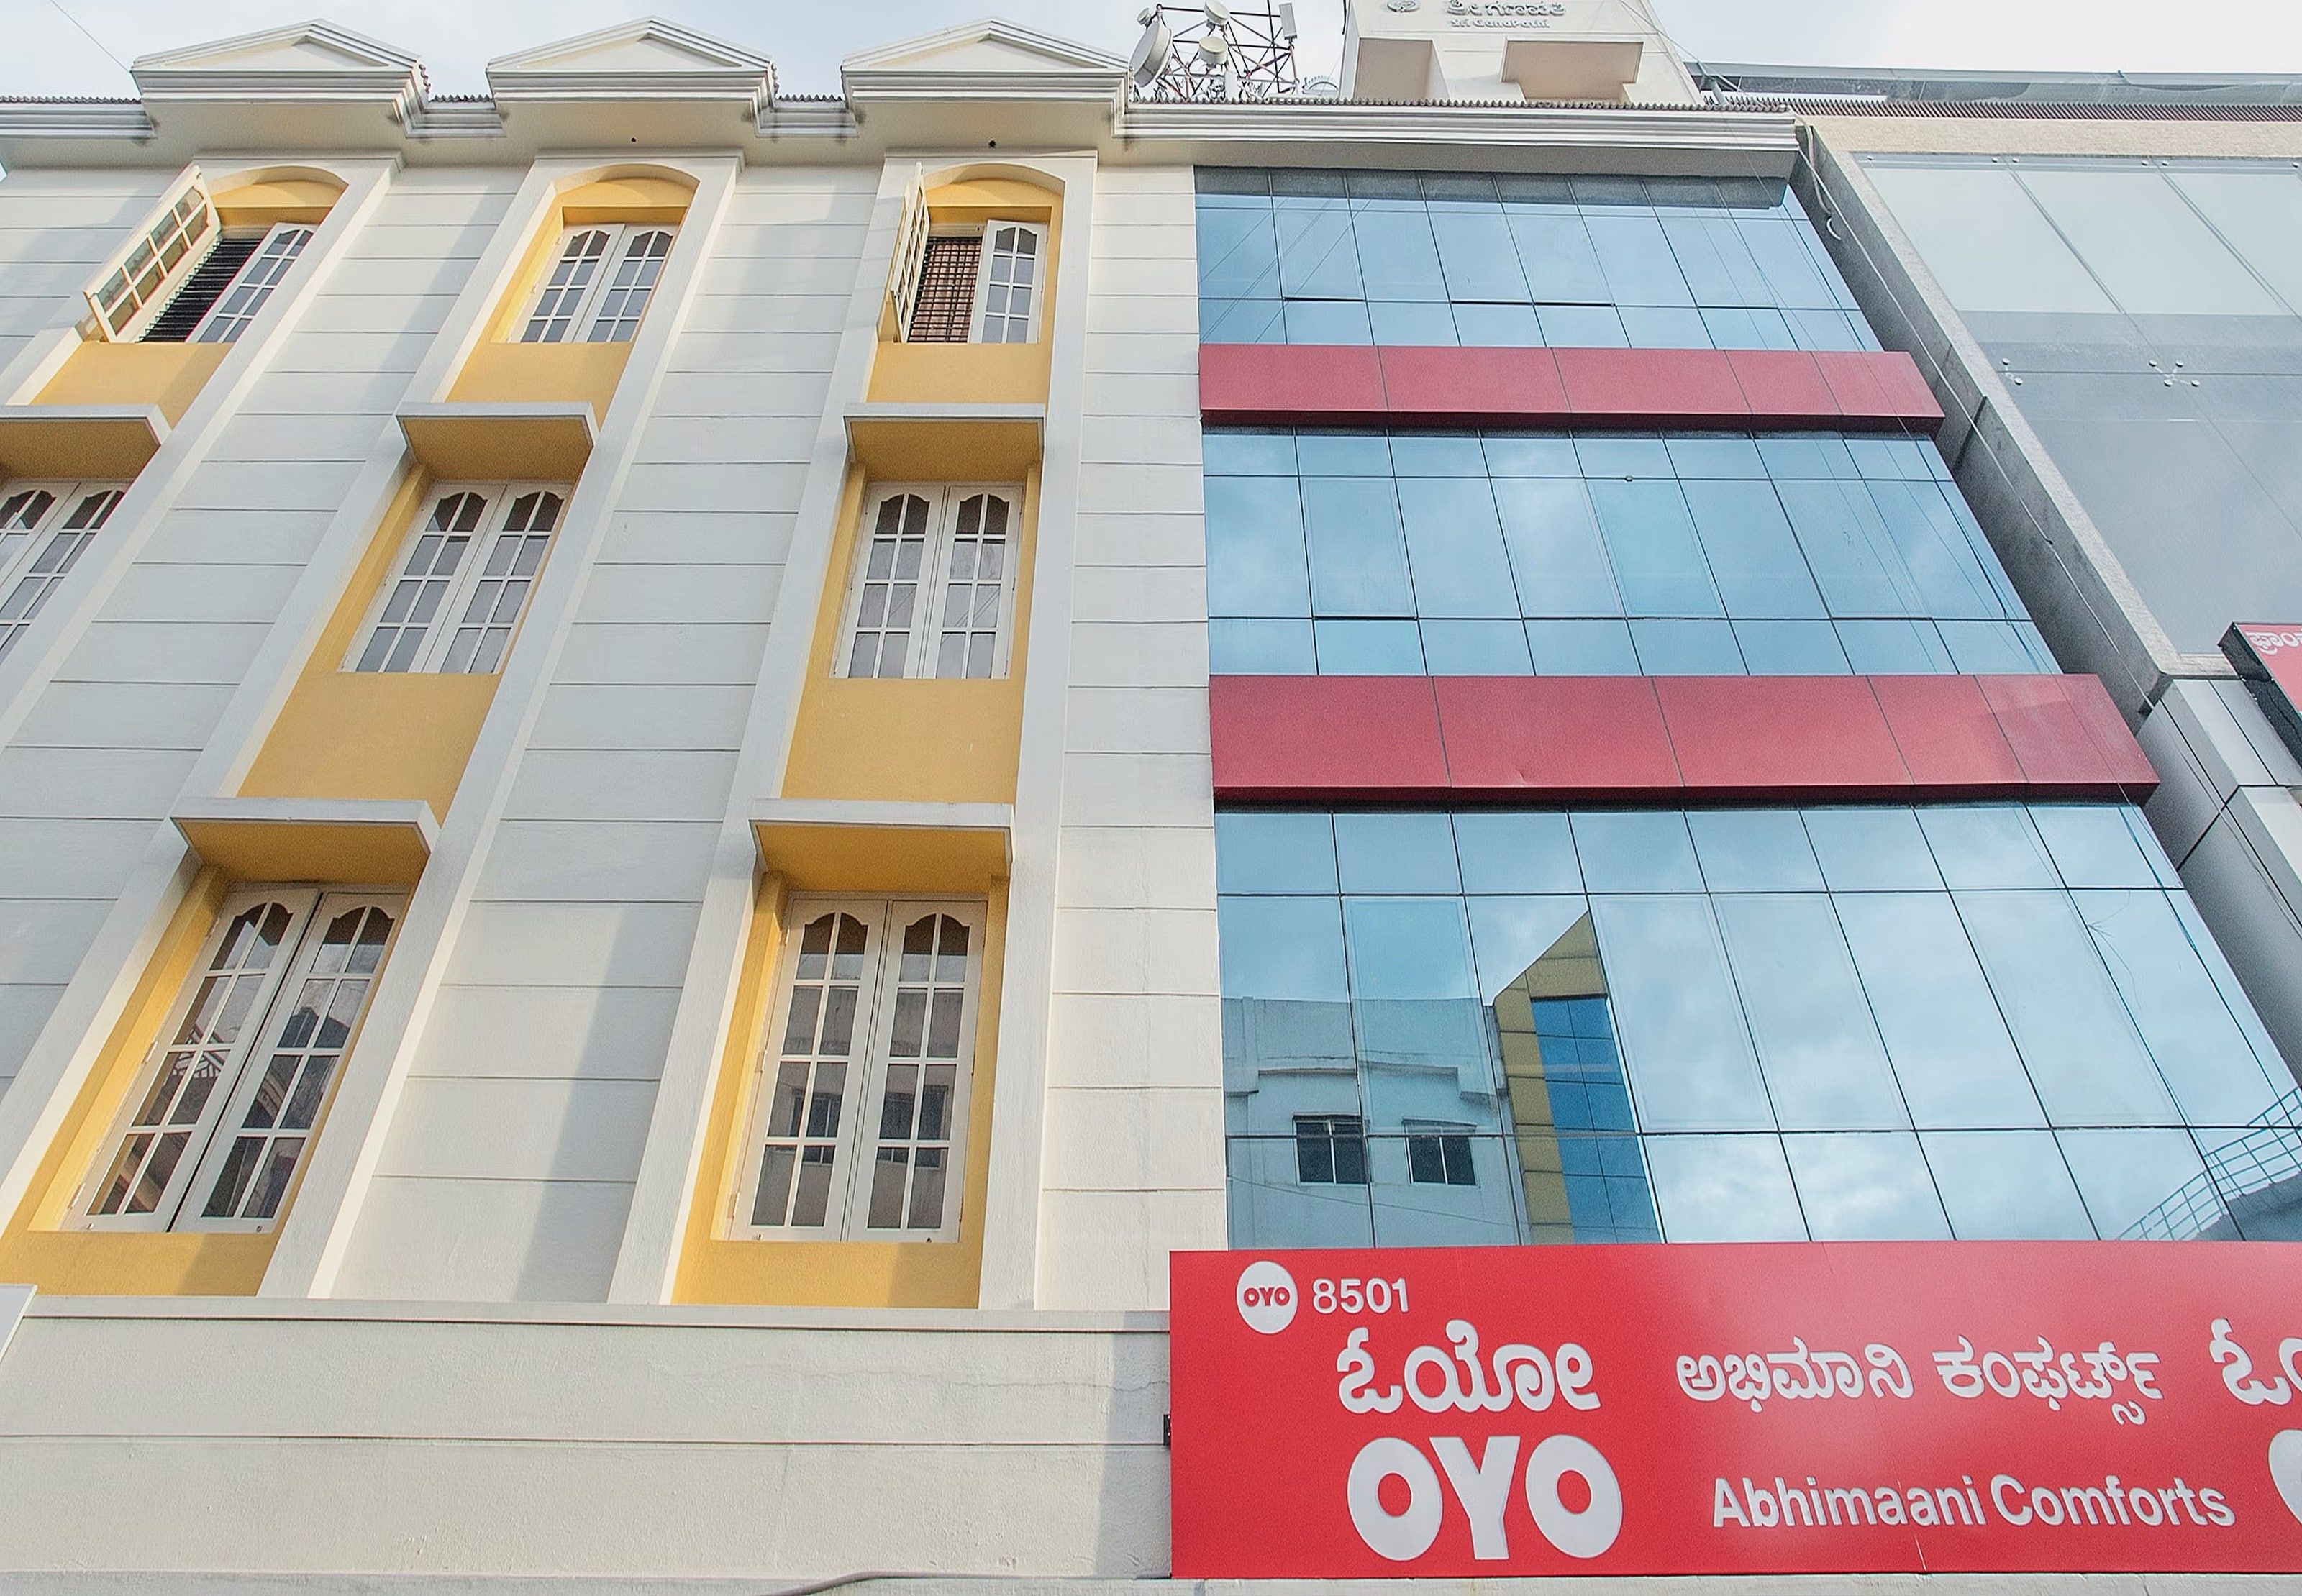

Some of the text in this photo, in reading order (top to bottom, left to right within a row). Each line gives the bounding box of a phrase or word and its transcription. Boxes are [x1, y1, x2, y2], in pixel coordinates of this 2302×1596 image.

[1450, 18, 1470, 28] Sri
[1243, 1277, 1409, 1314] OYO 8501
[1336, 1318, 2302, 1426] ಓಯೋ ಅಭಿಮಾನಿ ಕಂಫರ್ಟ್ಸ್ ಓ
[1347, 1434, 1623, 1561] OYO
[1713, 1475, 1987, 1528] Abhimaani
[1990, 1474, 2236, 1527] Comforts
